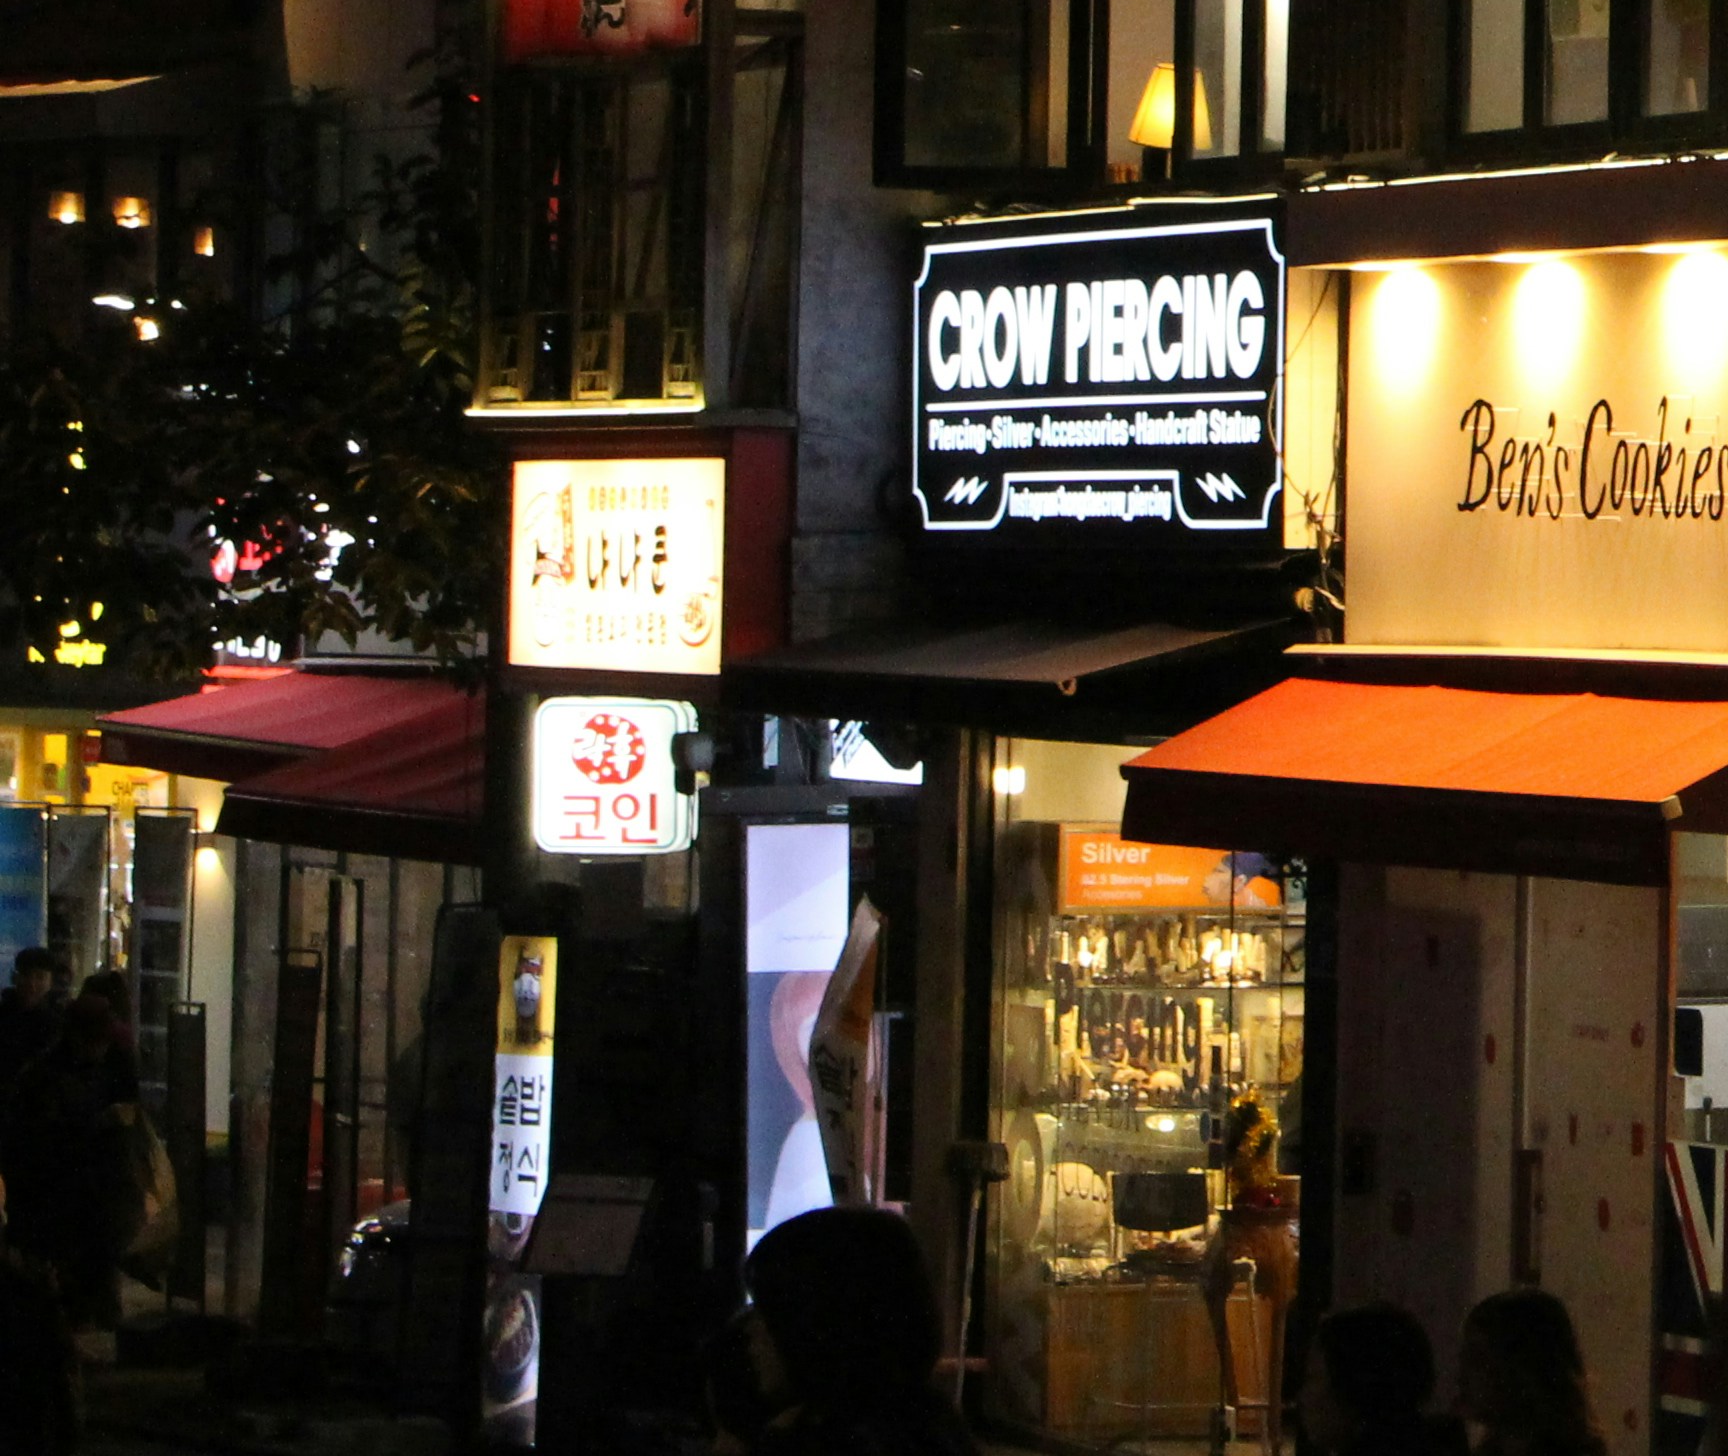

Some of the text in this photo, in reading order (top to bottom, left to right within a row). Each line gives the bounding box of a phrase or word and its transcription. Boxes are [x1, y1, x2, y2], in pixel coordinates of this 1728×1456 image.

[928, 269, 1266, 391] CROW PIERCING
[1209, 410, 1262, 444] Statue
[1457, 398, 1569, 521] Ben's
[586, 524, 669, 595] 냐냐쿤
[559, 793, 659, 844] 코인
[1081, 842, 1152, 864] Silver
[500, 1075, 545, 1126] 솥밥
[499, 1141, 540, 1198] 정식
